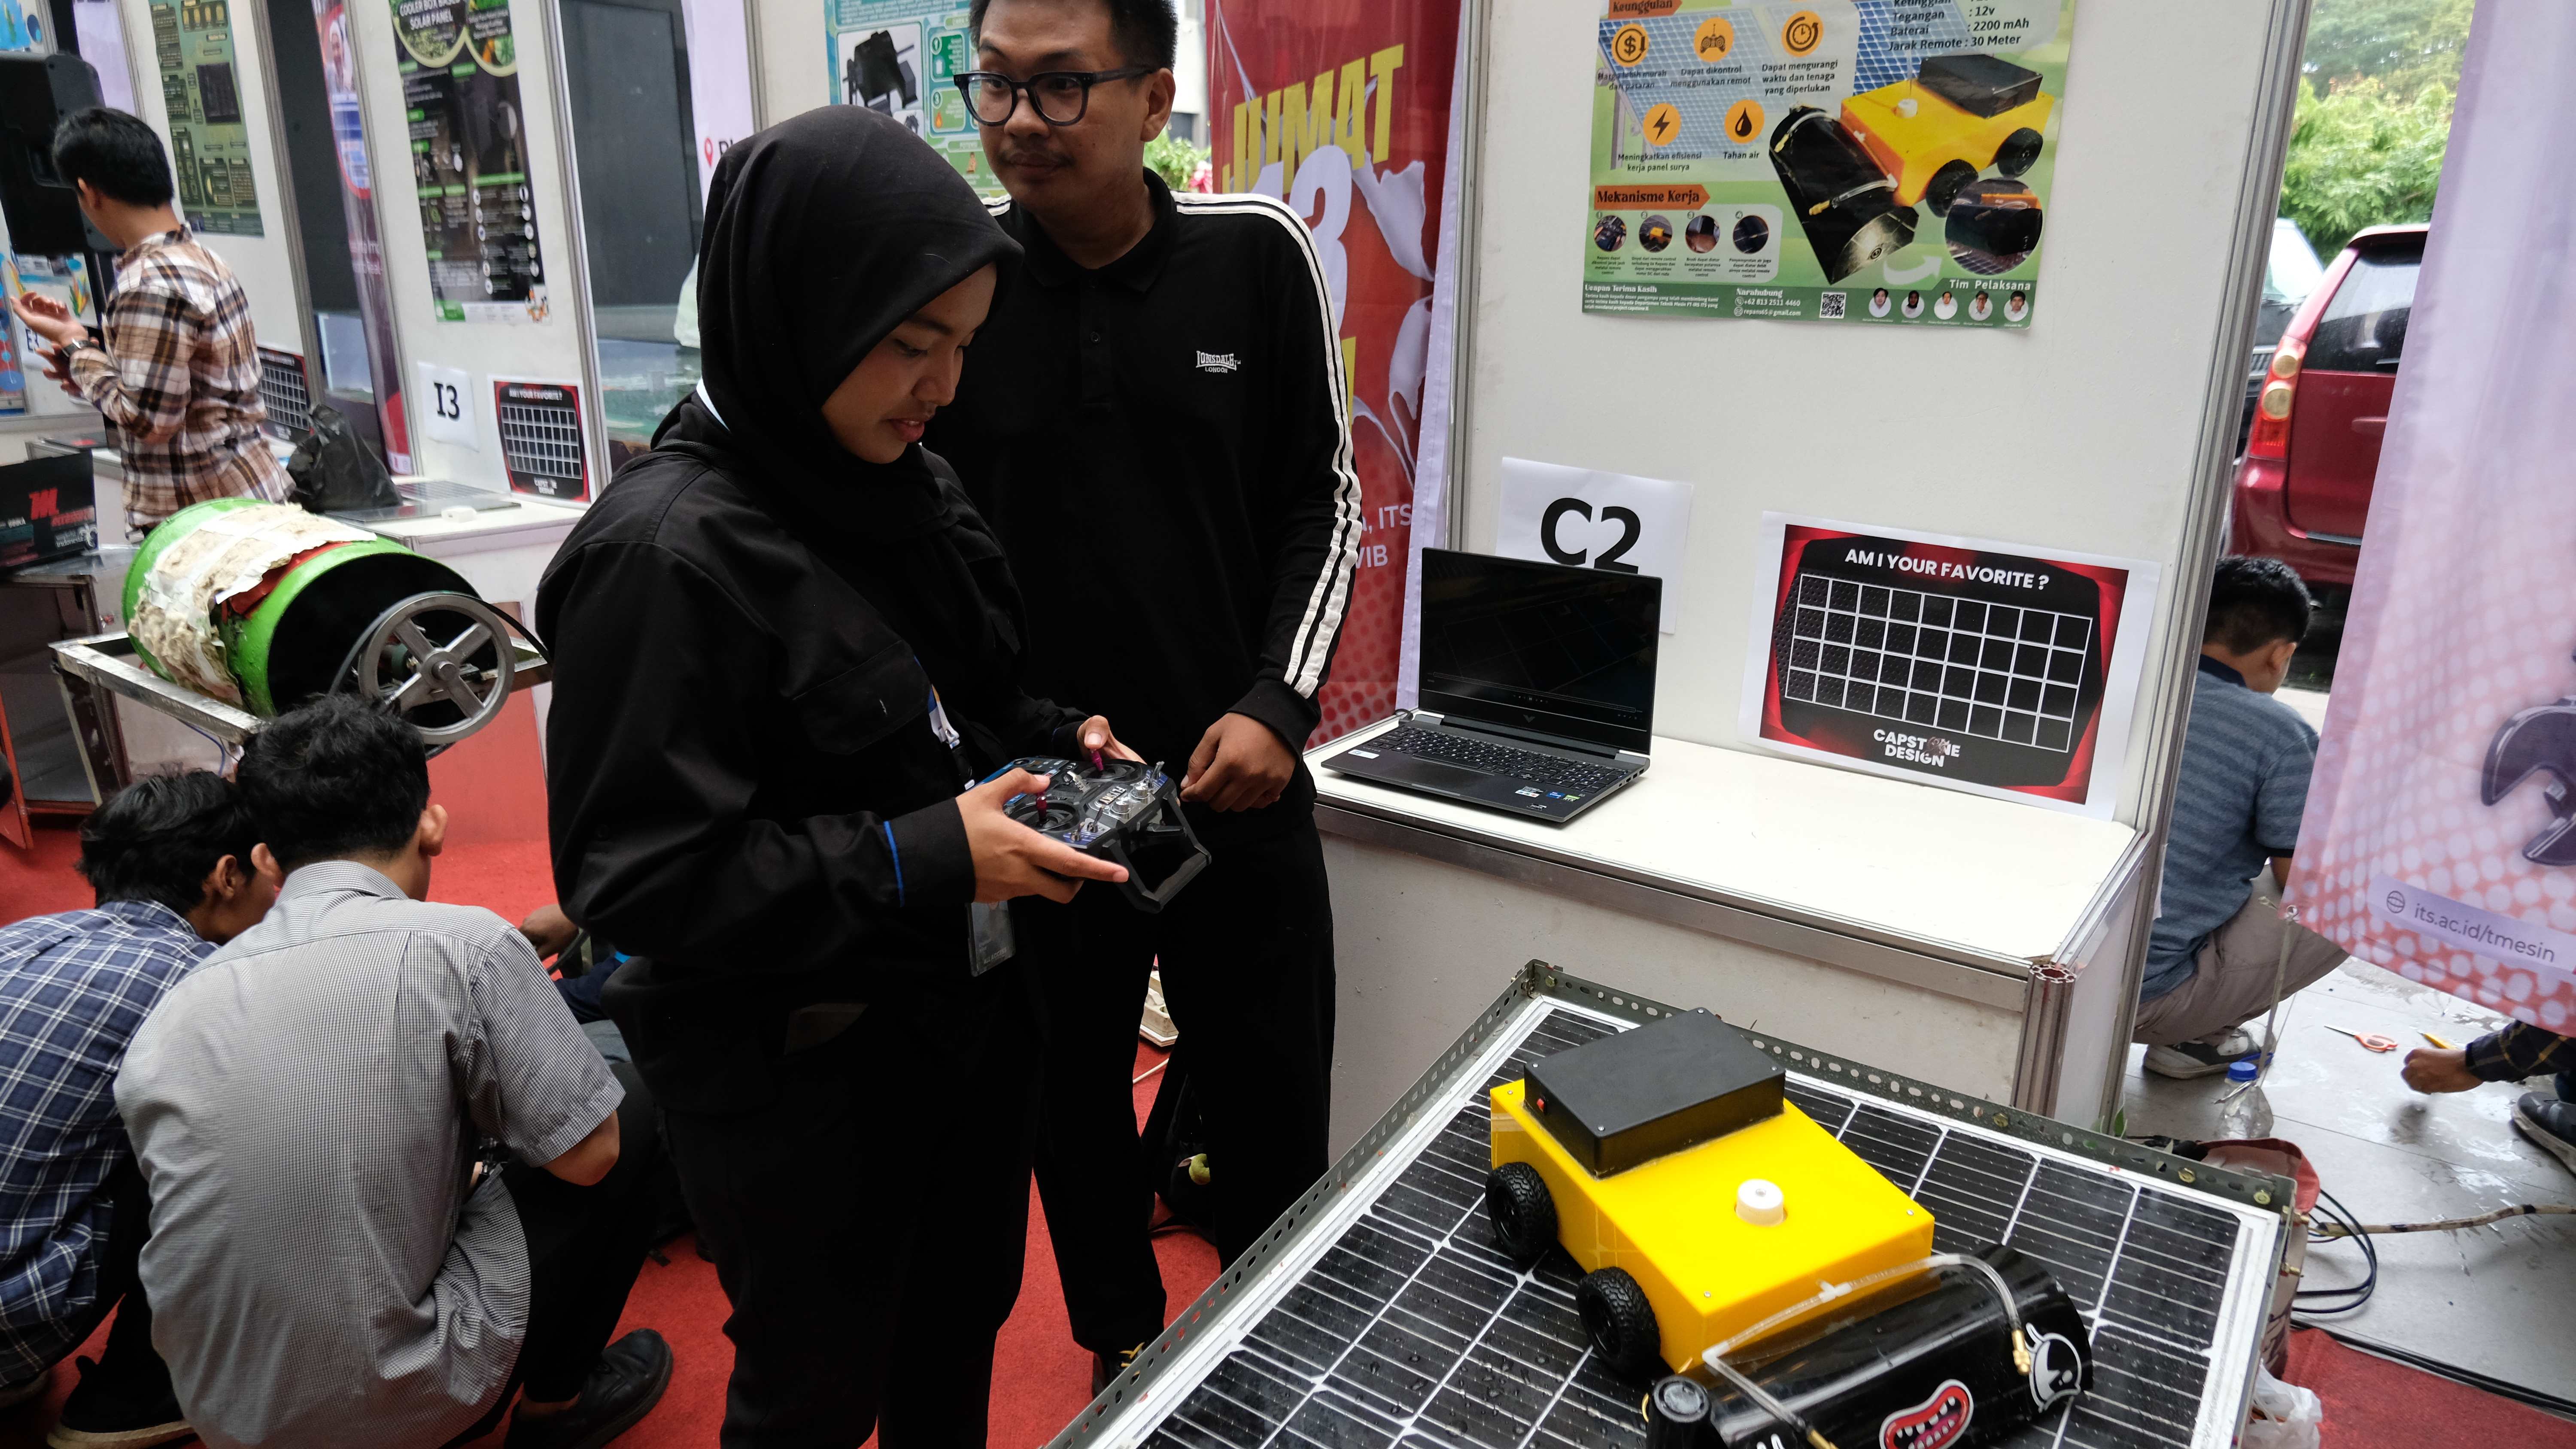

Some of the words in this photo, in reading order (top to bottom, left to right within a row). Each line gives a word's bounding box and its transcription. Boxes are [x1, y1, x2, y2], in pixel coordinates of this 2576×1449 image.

[1613, 0, 1672, 15] Keunggulan
[1893, 10, 1944, 22] Tegangan
[1975, 6, 1995, 17] 12v
[410, 12, 431, 30] SOLAR
[431, 8, 454, 24] PANEL
[1891, 25, 1929, 36] Baterai
[1973, 21, 2000, 32] 2200
[2004, 18, 2029, 29] mAh
[1888, 40, 1917, 51] Jarak
[1920, 39, 1962, 49] Remote
[1971, 37, 1984, 46] 30
[1987, 35, 2021, 45] Meter
[1681, 68, 1704, 77] Dapat
[1706, 65, 1742, 74] dikontrol
[1762, 64, 1786, 73] Dapat
[1789, 59, 1838, 71] mengurangi
[1598, 72, 1620, 81] Harga
[1671, 78, 1725, 88] menggunakan
[1762, 74, 1786, 83] waktu
[1789, 73, 1804, 81] dan
[1807, 73, 1835, 81] tenaga
[1765, 87, 1784, 96] yang
[1786, 84, 1830, 95] diperlukan
[1222, 43, 1403, 194] JUMAT
[1618, 153, 1669, 162] Meningkatkan
[1671, 152, 1702, 160] efisiensi
[1723, 152, 1747, 160] Tahan
[1627, 164, 1645, 173] kerja
[1647, 163, 1668, 173] panel
[1670, 164, 1689, 173] surya
[1597, 190, 1665, 203] Mekanisme
[1668, 190, 1700, 205] Kerja
[1585, 284, 1610, 293] Ucapan
[1950, 279, 1968, 289] Tim
[1975, 280, 2031, 291] Pelaksana
[1736, 288, 1783, 298] Narahubung
[1196, 351, 1236, 370] LONSDALE
[434, 382, 460, 421] I3
[1379, 504, 1412, 529] ITS
[1540, 497, 1641, 574] C2
[1845, 549, 1874, 566] AM
[1877, 553, 1883, 567] I
[1887, 554, 1937, 575] YOUR
[1941, 562, 2035, 589] FAVORITE
[2038, 574, 2050, 591] ?
[1885, 744, 1945, 767] DESIGN
[1098, 786, 1127, 805] FLYSKY
[2415, 903, 2555, 963] its.ac.id/tmesin
